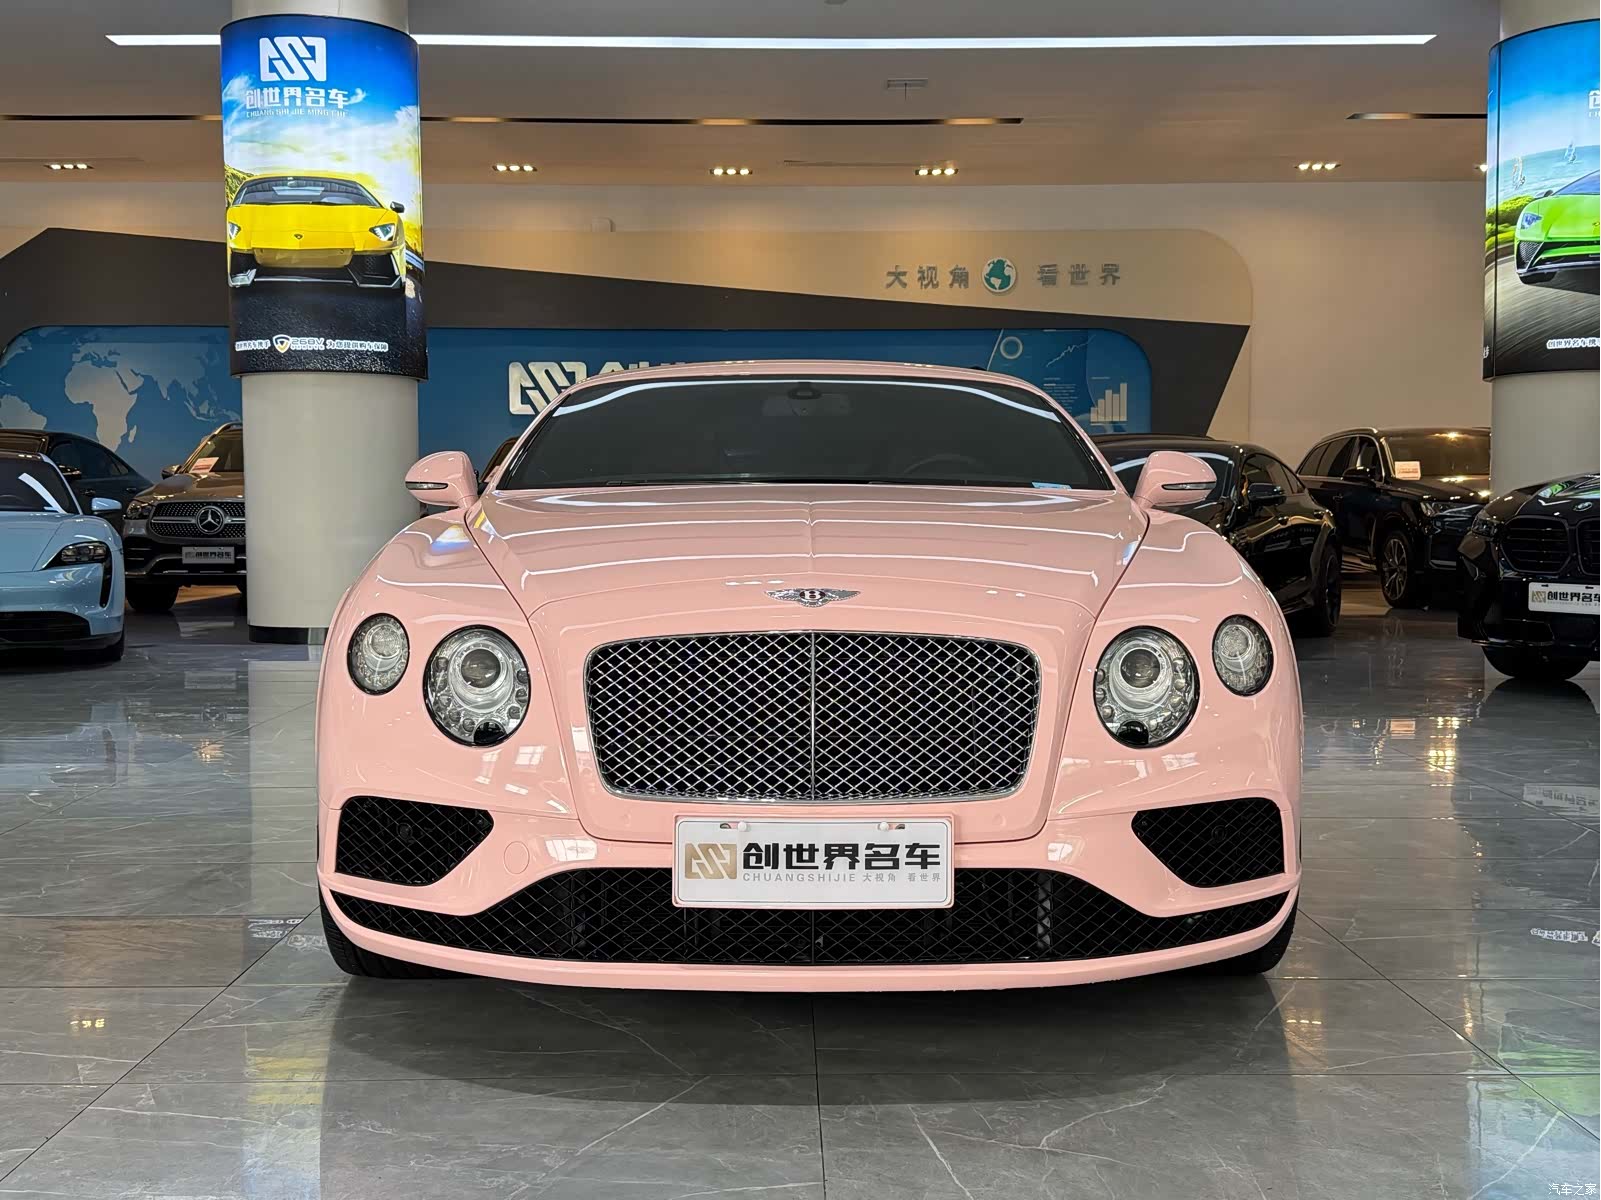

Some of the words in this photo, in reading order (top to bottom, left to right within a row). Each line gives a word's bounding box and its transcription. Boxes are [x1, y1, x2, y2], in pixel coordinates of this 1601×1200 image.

[246, 86, 348, 109] 创世界名车
[886, 265, 970, 290] 大视角
[1037, 263, 1121, 287] 看世界
[1547, 338, 1600, 349] 创世界名车携
[742, 843, 941, 870] 创世界名车
[743, 873, 856, 882] CHUANGSHIJIE
[863, 873, 897, 882] 大视角
[907, 873, 941, 882] 看世界
